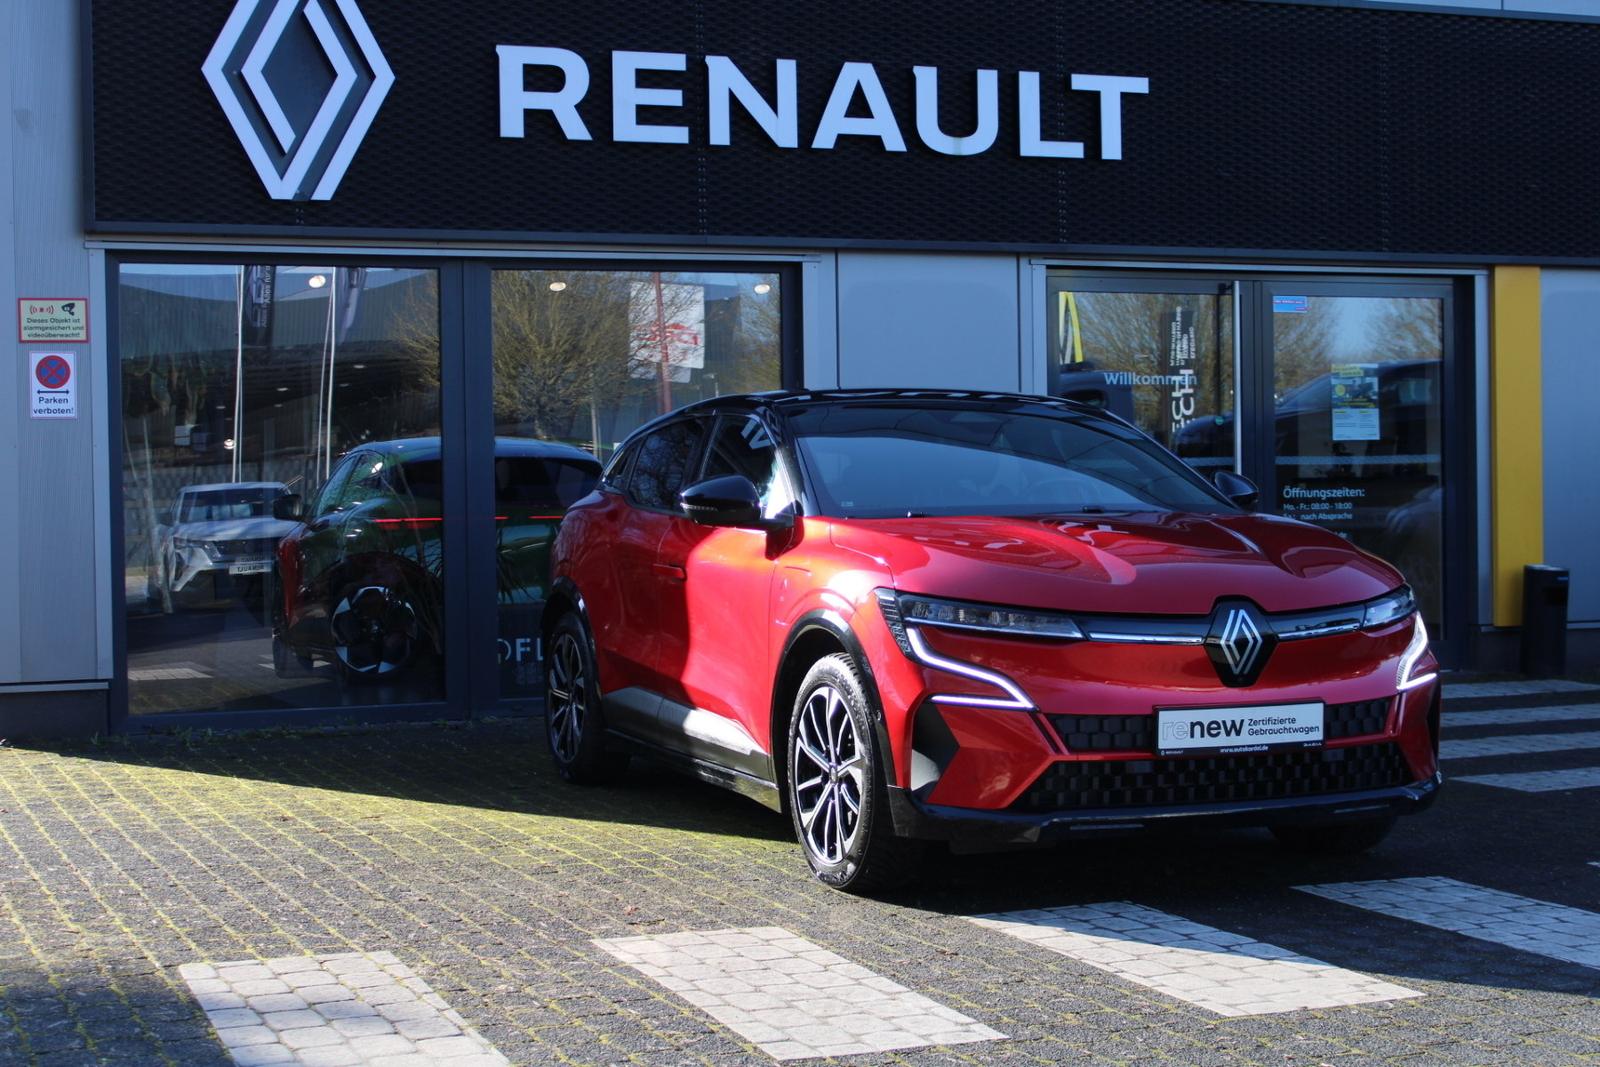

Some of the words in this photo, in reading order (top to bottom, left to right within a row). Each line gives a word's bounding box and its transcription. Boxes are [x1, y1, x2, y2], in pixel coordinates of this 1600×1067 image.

[495, 44, 1150, 161] RENAULT
[38, 396, 69, 404] Parken
[1283, 486, 1365, 500] Öffnungszeiten:
[1335, 502, 1352, 510] 18:00
[1318, 512, 1353, 521] Absprache
[1248, 717, 1297, 726] Zertifizierte
[1161, 719, 1245, 740] renew
[1248, 725, 1320, 736] Gebrauchtwagen
